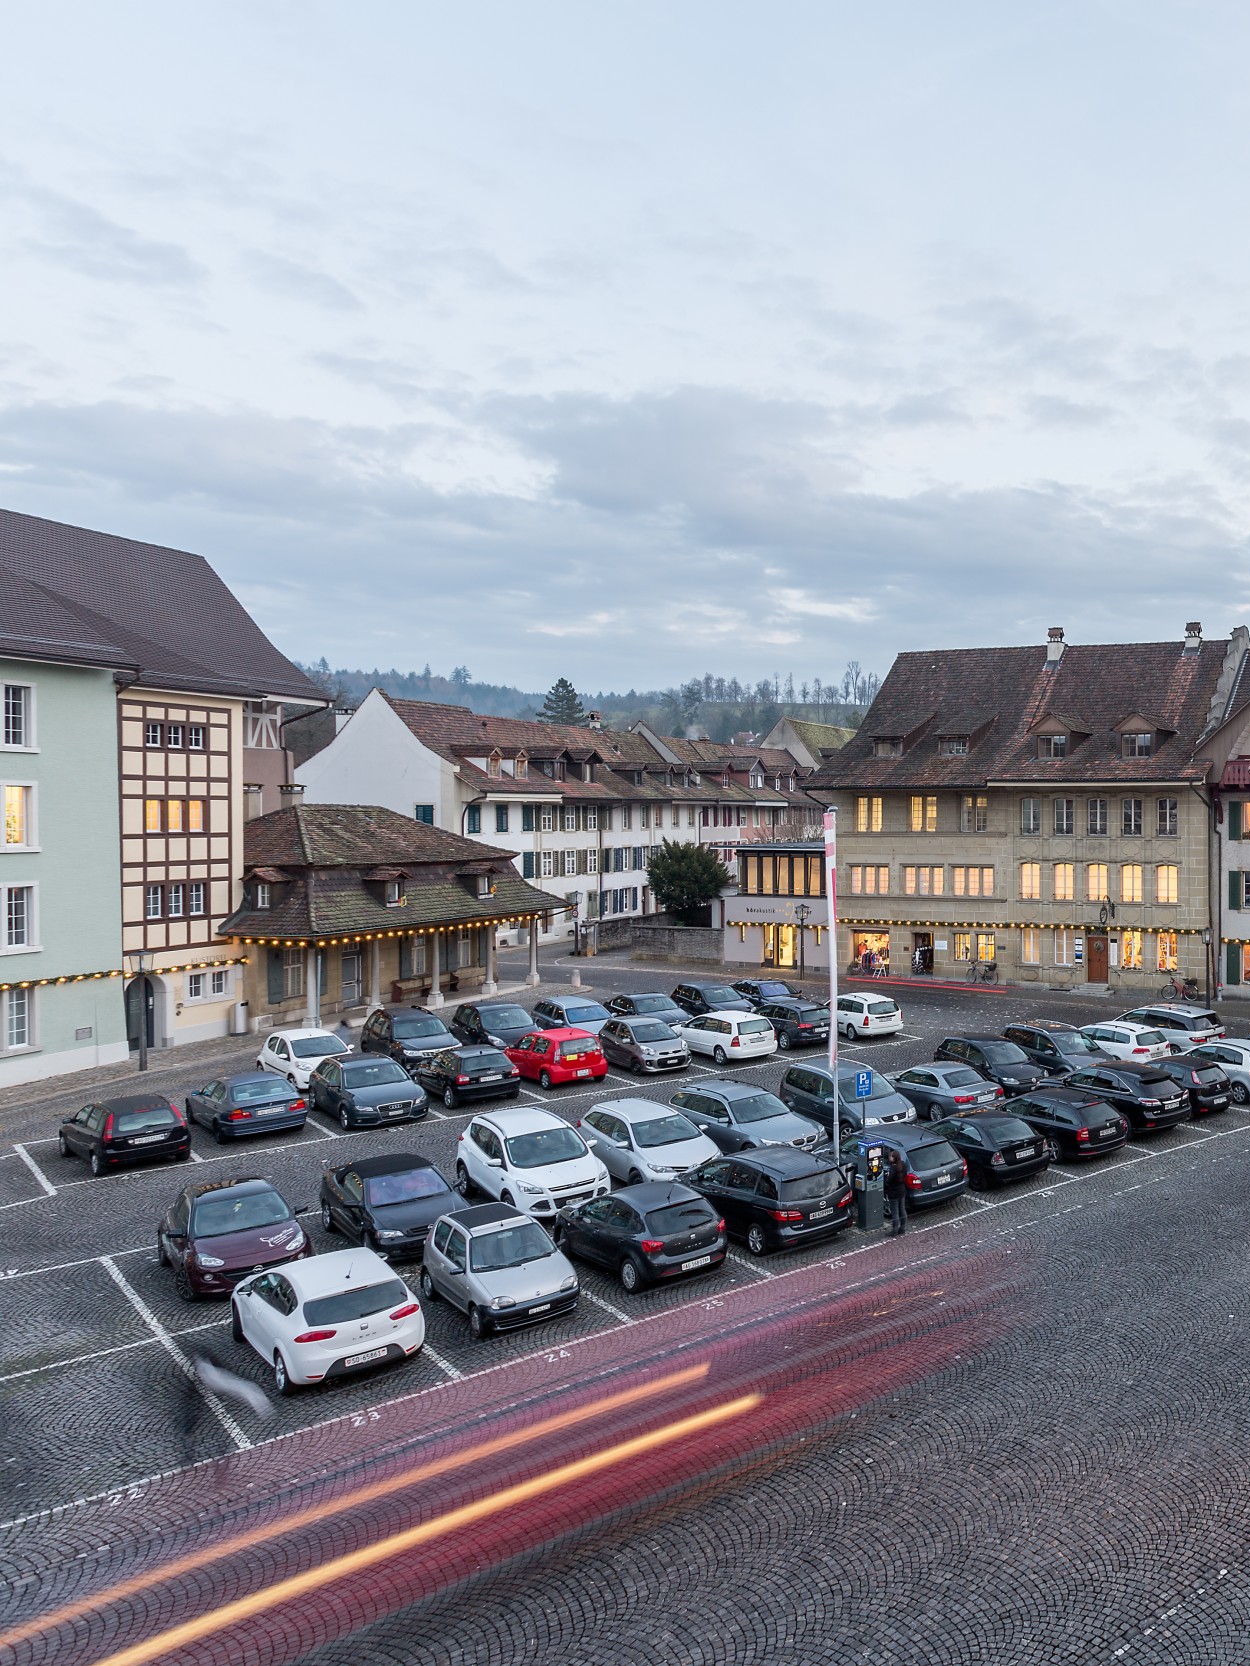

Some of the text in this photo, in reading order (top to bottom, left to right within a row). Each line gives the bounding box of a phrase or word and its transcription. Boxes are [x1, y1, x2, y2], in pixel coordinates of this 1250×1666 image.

[700, 1299, 724, 1310] 25
[544, 1349, 571, 1363] 24
[350, 1410, 382, 1427] 23
[107, 1487, 145, 1507] 22
